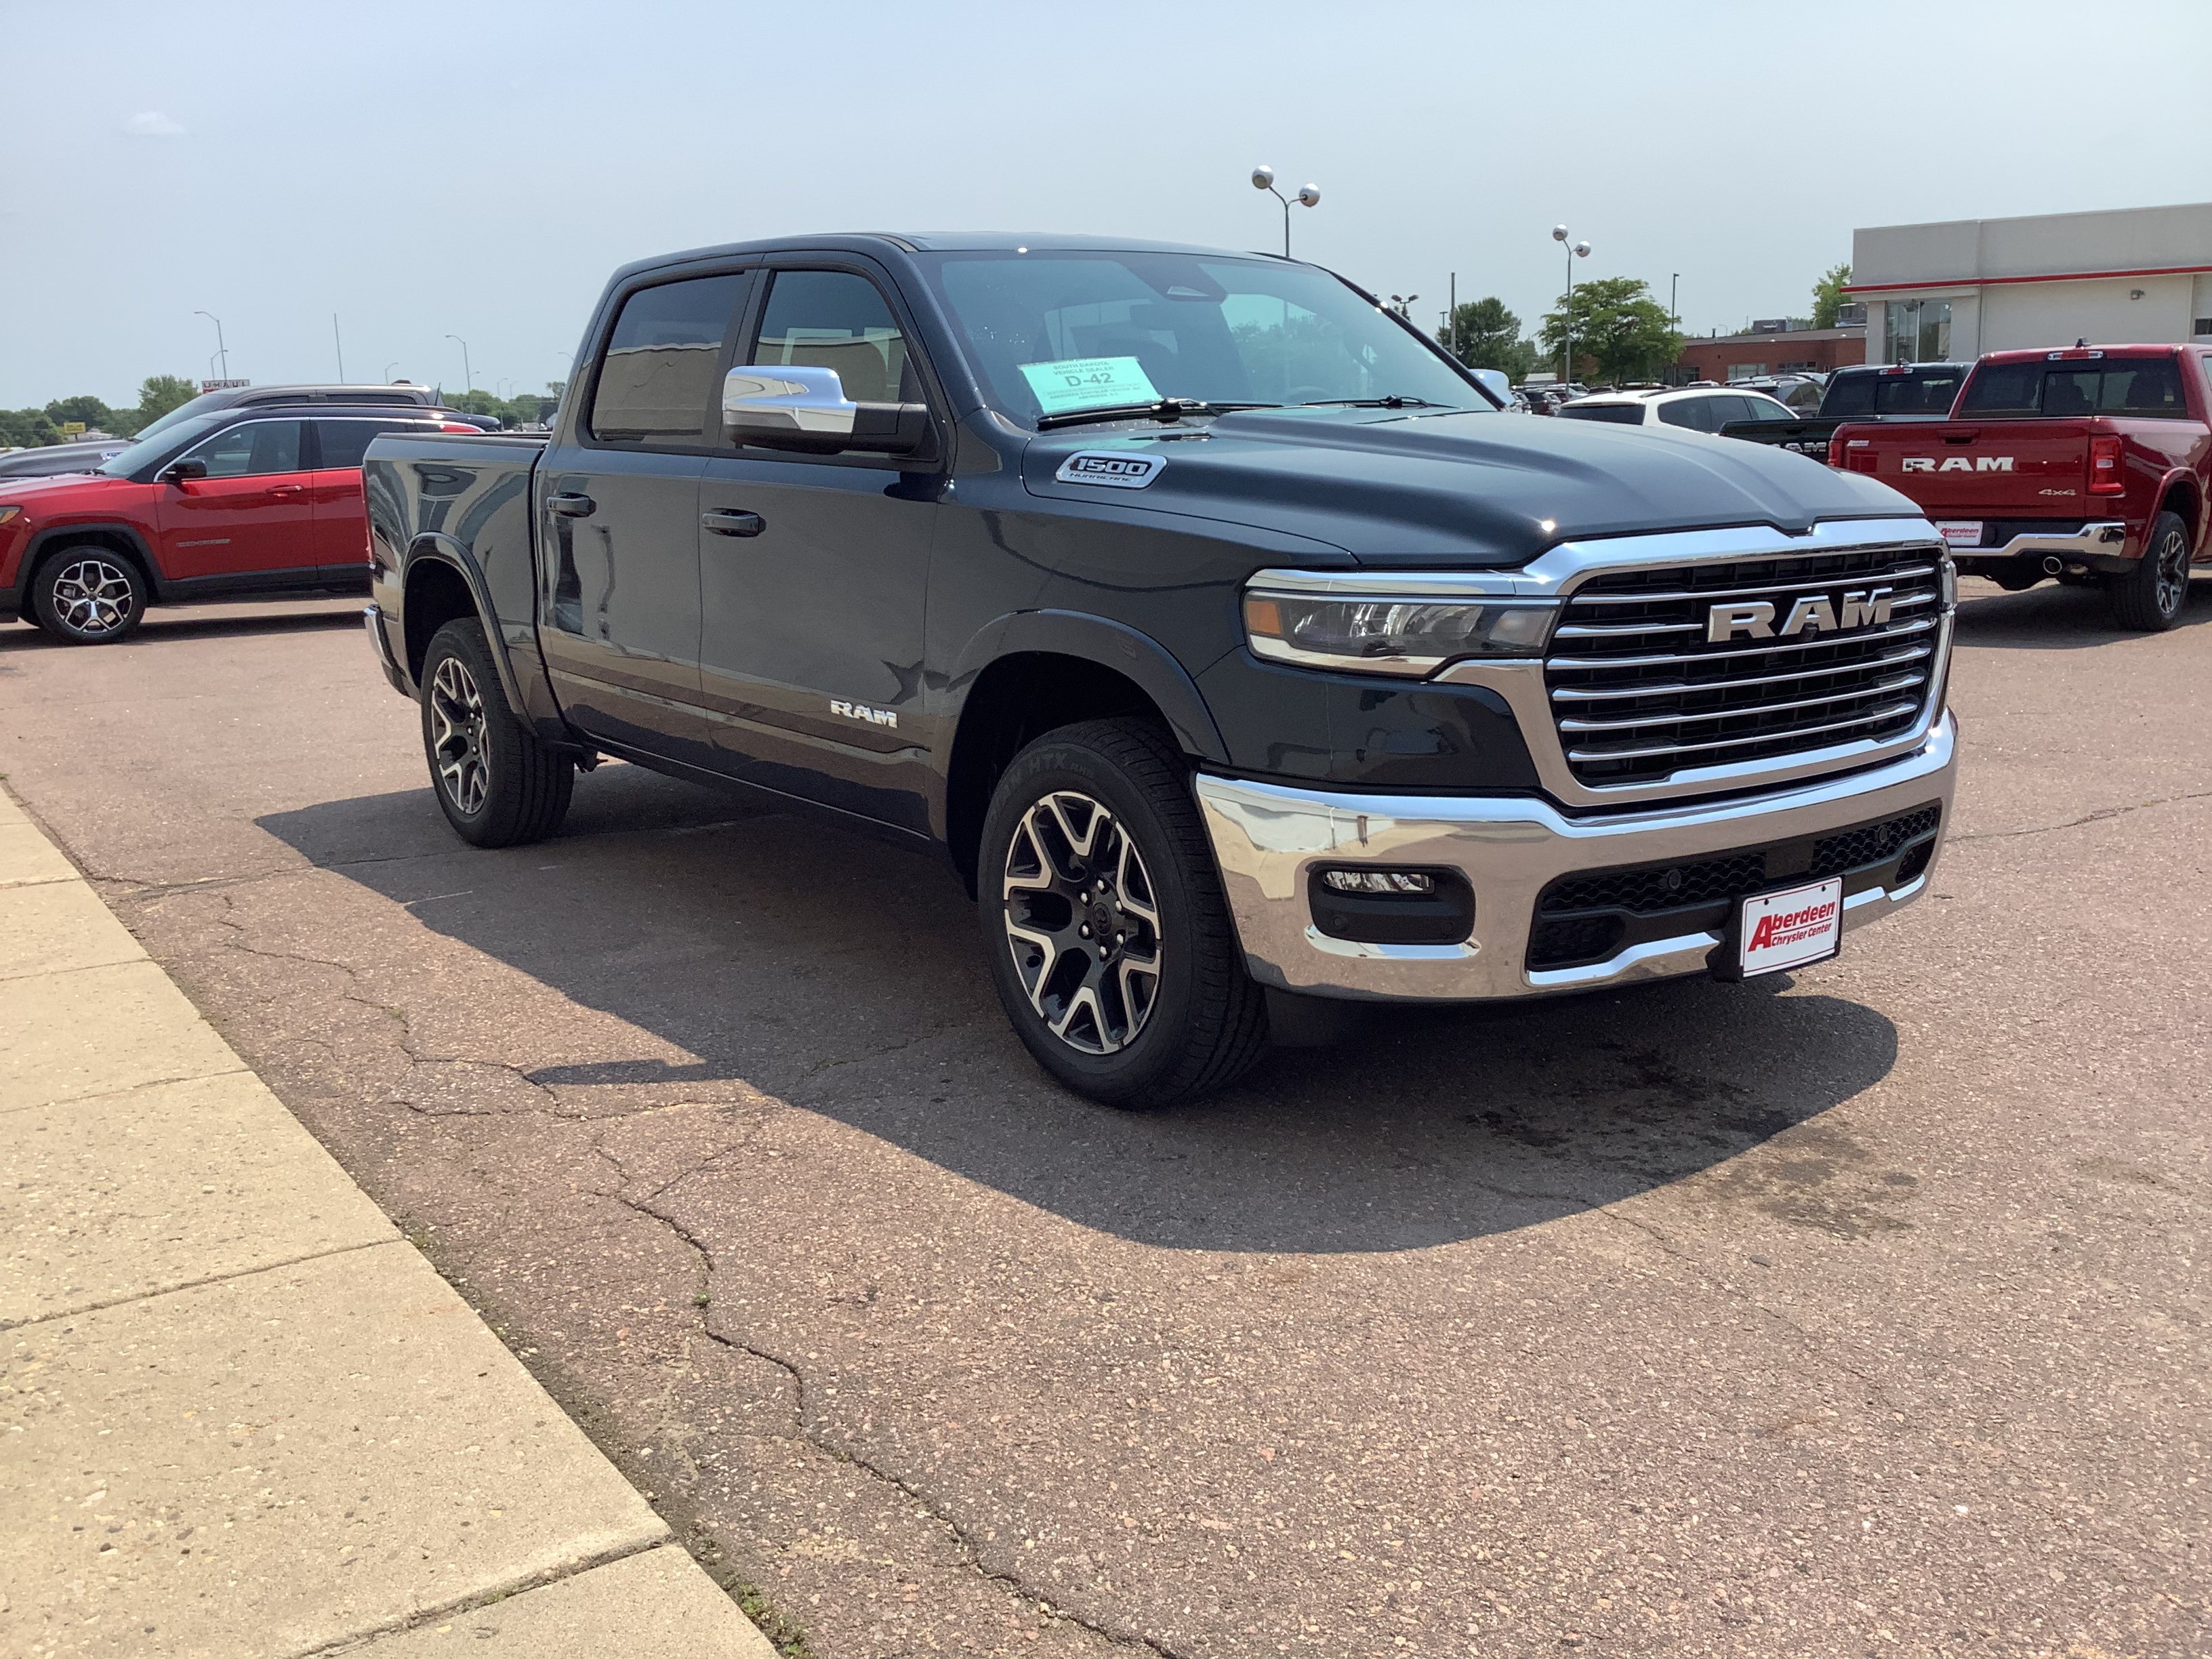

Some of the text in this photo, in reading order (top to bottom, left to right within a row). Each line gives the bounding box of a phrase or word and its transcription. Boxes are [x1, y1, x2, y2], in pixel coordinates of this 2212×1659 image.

[1065, 373, 1115, 386] D-42
[1767, 442, 1826, 453] AM
[1078, 458, 1149, 475] 1500
[1902, 457, 2014, 472] RAM
[1069, 472, 1133, 482] HURRICANE
[1707, 587, 1893, 643] RAM
[830, 699, 898, 729] RAM
[1747, 901, 1836, 952] Aberdeen
[1771, 922, 1832, 947] Chrysler Center
